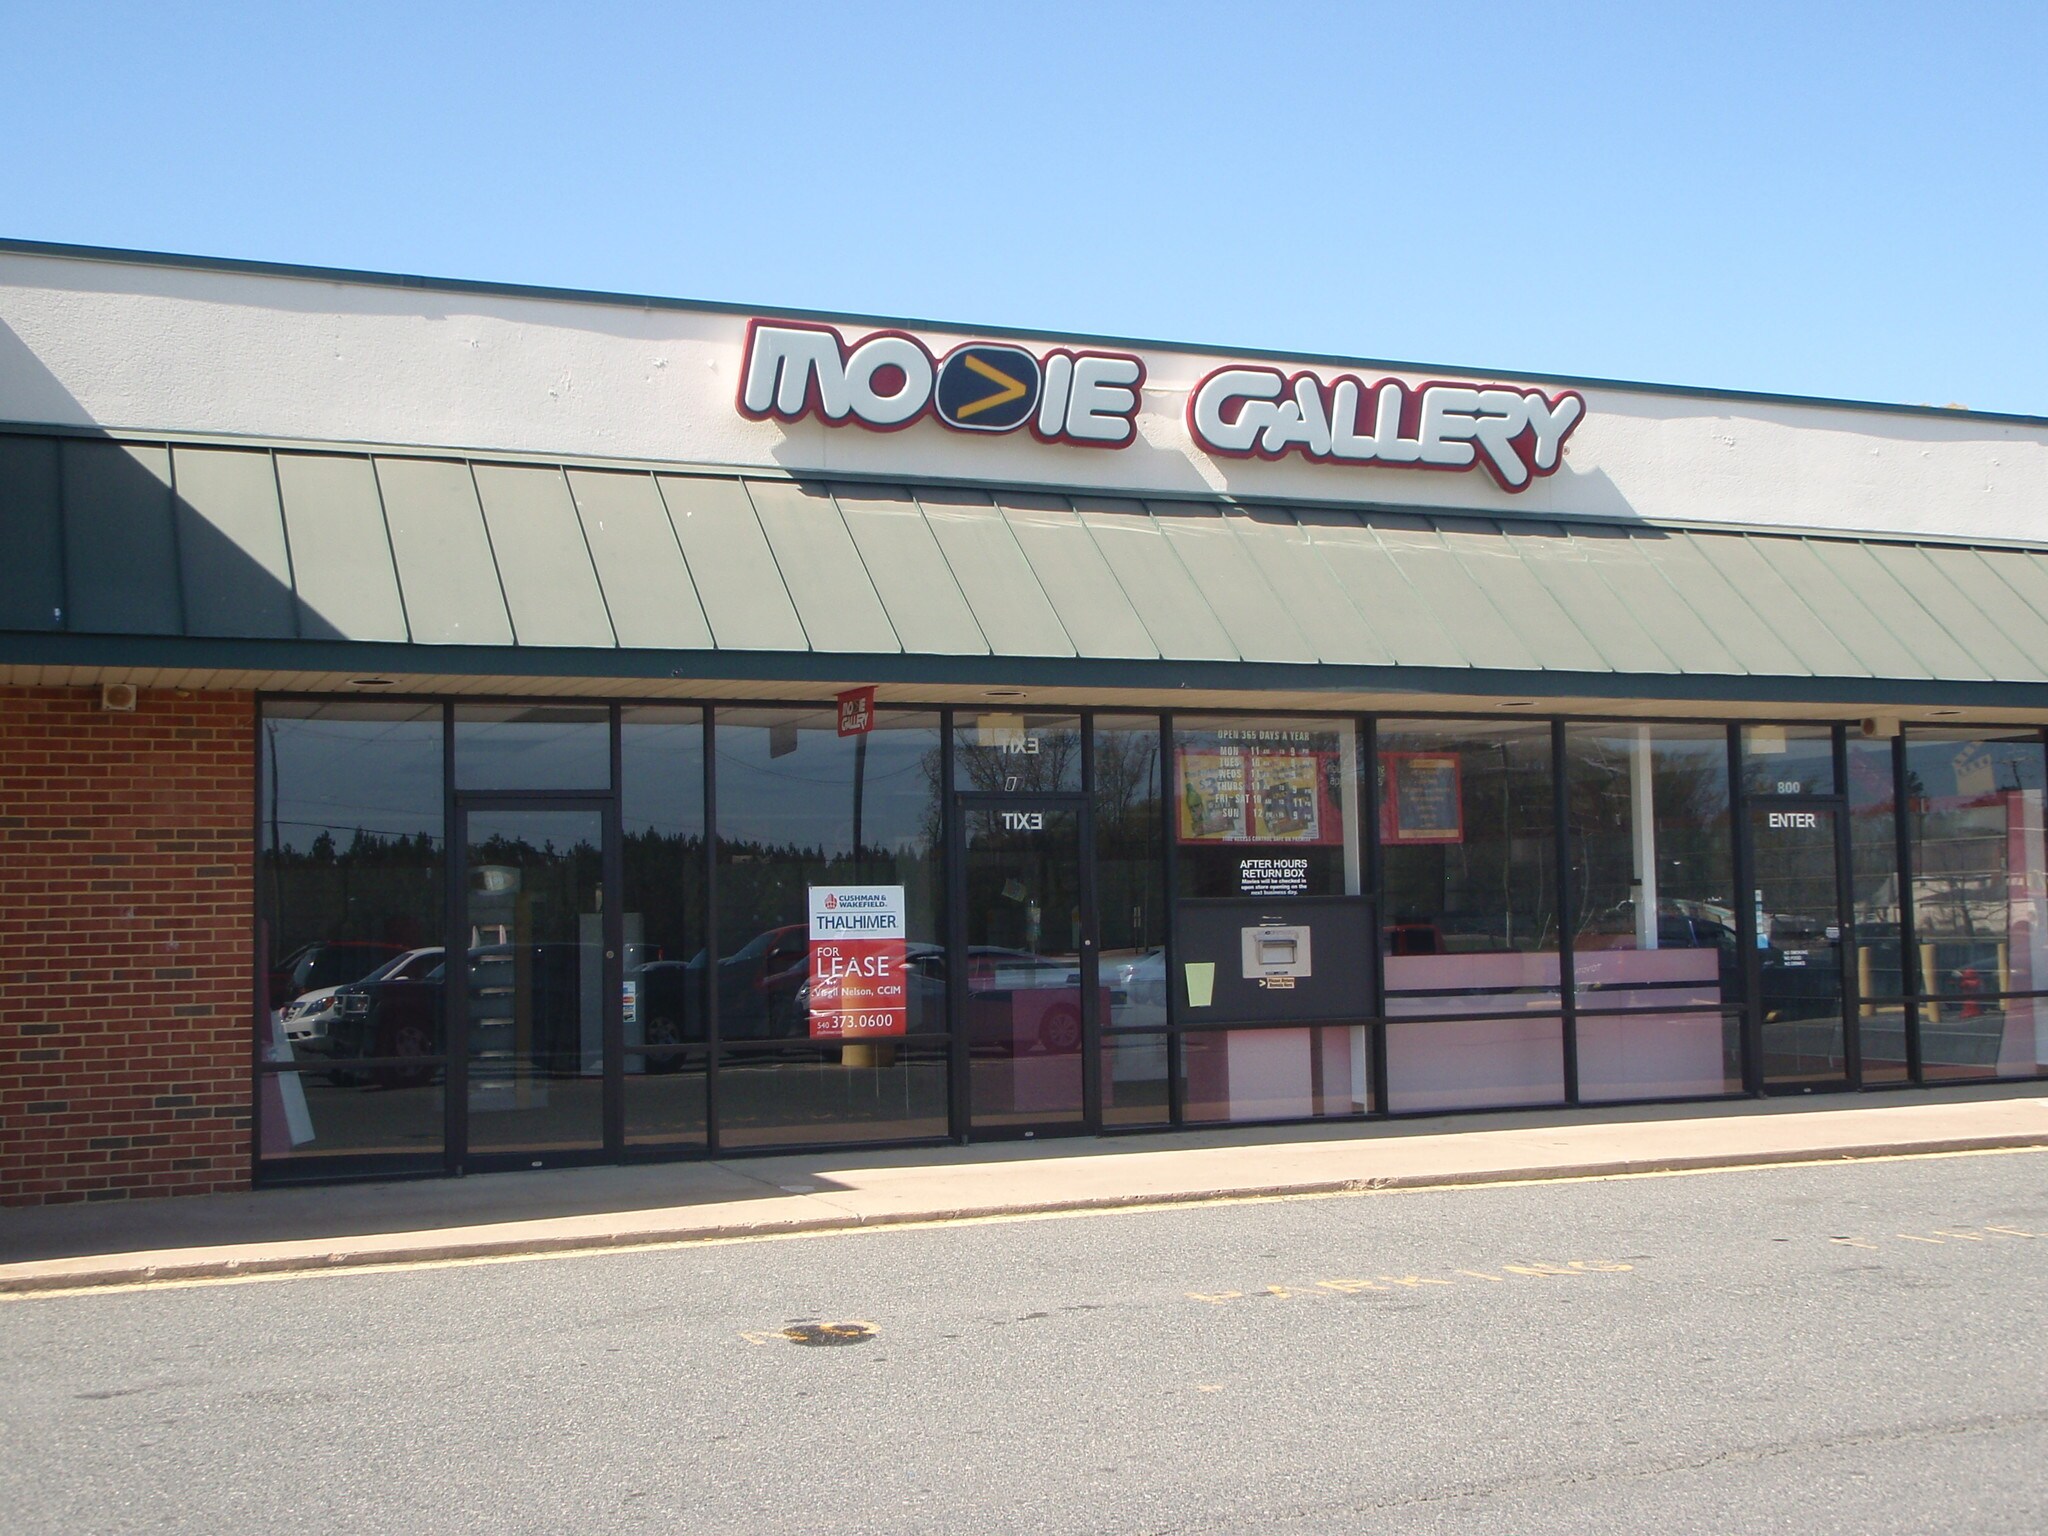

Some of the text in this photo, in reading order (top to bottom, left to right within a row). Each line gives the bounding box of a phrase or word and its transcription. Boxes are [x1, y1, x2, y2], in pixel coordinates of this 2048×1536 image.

[1189, 367, 1586, 492] GALLERY
[842, 712, 868, 731] GALLERY
[1218, 730, 1310, 740] OPEN 365 DAYS A YEAR
[1220, 746, 1238, 756] MON
[1251, 746, 1259, 755] 11
[1290, 747, 1295, 756] 9
[1220, 758, 1240, 767] TUES
[1217, 781, 1244, 790] THURS
[1778, 782, 1800, 794] 800
[1222, 809, 1239, 817] SUN
[1254, 809, 1263, 817] 12
[1769, 813, 1816, 828] ENTER
[1240, 859, 1308, 868] AFTER HOURS
[1243, 869, 1304, 878] RETURN BOX
[816, 915, 896, 929] THALHIMER
[817, 947, 840, 956] FOR
[818, 956, 889, 978] LEASE
[815, 986, 901, 999] Virgil Nelson, CCIM
[832, 1014, 892, 1028] 373.0600
